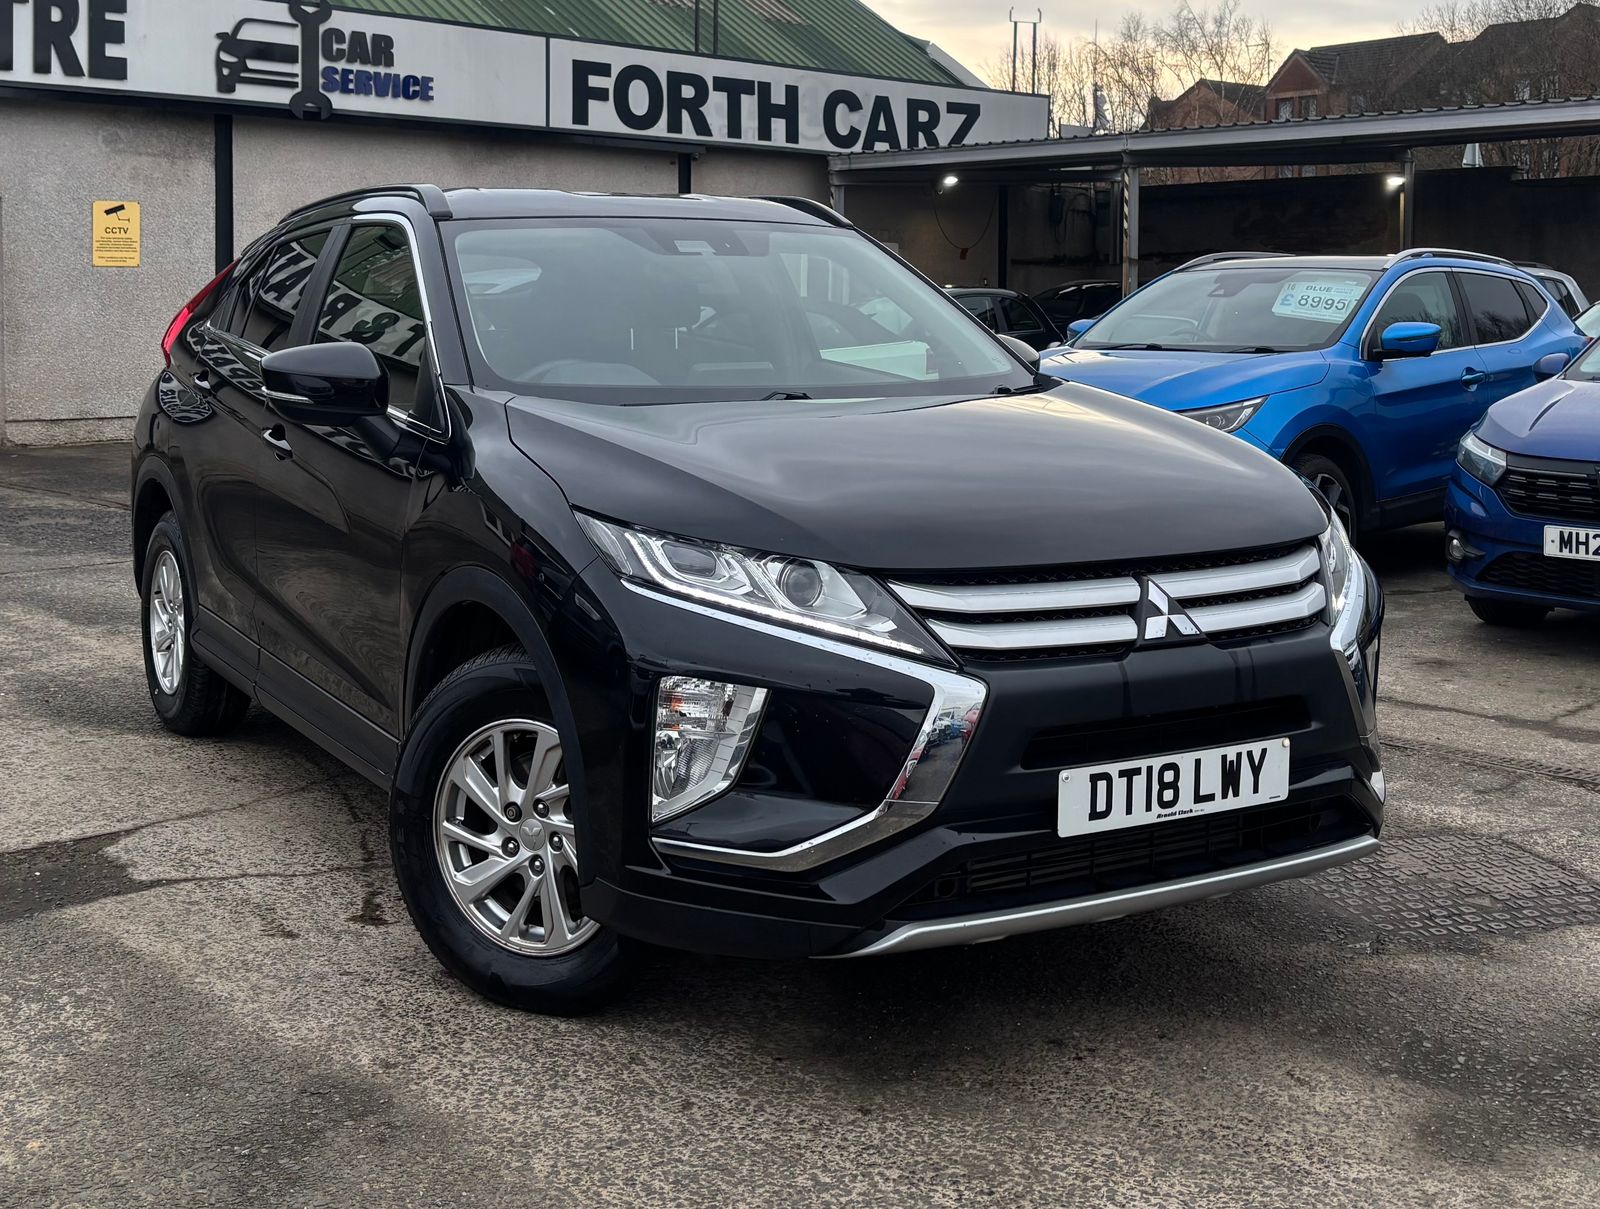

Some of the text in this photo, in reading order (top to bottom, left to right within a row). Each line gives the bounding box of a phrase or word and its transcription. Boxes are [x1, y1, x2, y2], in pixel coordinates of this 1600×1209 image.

[321, 27, 395, 68] CAR
[321, 66, 434, 102] SERVICE
[572, 58, 799, 145] FORTH
[104, 226, 129, 235] CCTV
[1306, 285, 1334, 293] BLUE
[1558, 530, 1600, 557] MH2
[1088, 747, 1268, 822] DT18 LWY
